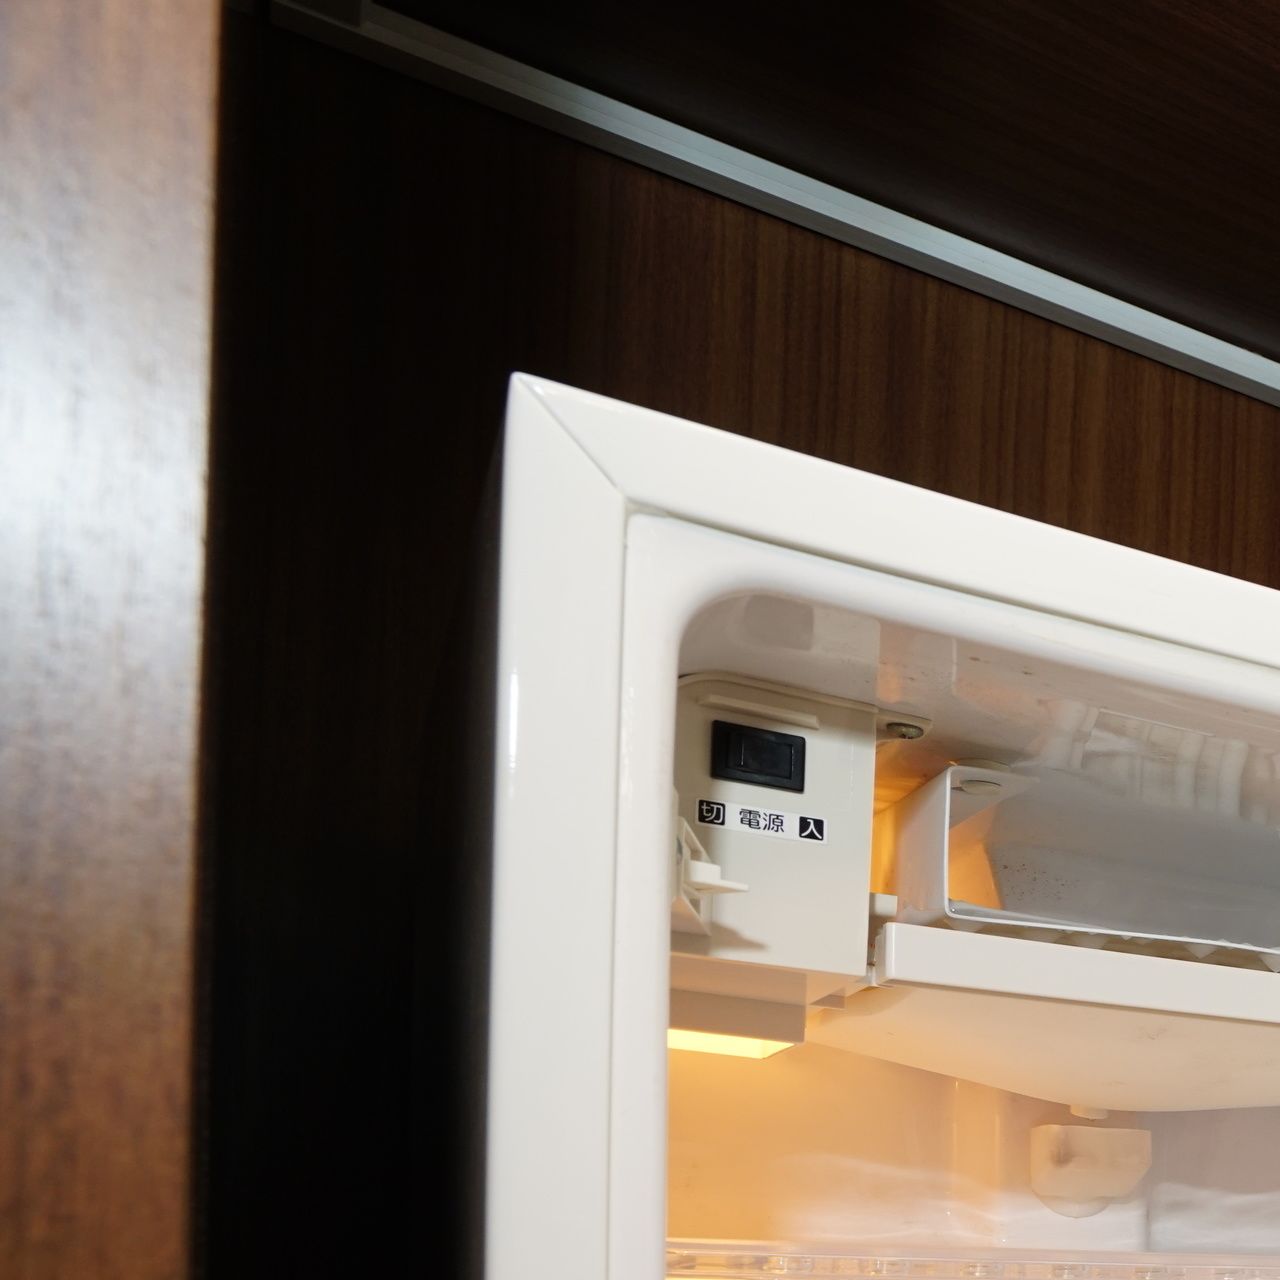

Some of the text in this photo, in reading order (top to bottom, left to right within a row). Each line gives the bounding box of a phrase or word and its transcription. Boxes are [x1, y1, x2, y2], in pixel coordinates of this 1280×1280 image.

[700, 801, 823, 840] 切 電源 入
